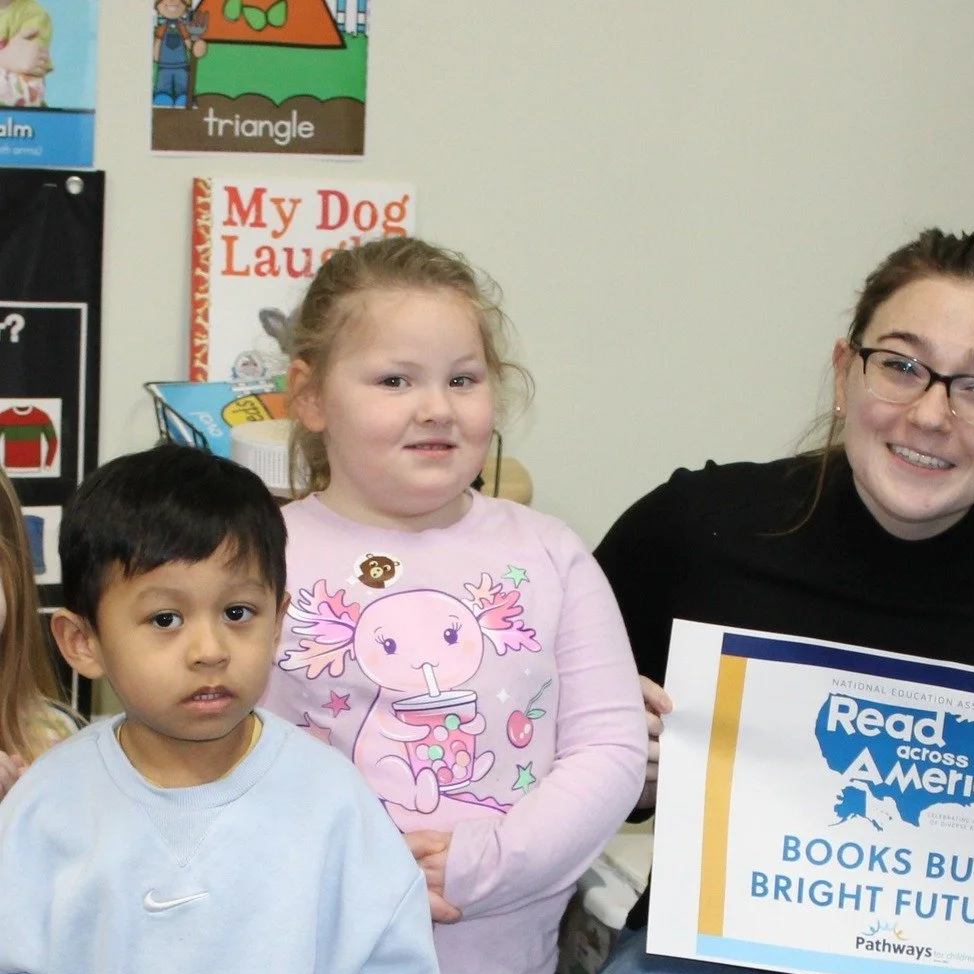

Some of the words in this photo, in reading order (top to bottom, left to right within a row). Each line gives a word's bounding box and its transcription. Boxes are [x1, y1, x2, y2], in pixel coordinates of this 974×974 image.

[204, 107, 315, 145] triangle
[222, 186, 302, 239] My
[315, 189, 409, 237] Dog
[221, 235, 361, 278] Lau
[832, 678, 887, 694] NATIONAL
[891, 688, 954, 706] EDUCATION
[827, 696, 946, 748] Read
[896, 744, 970, 768] across
[782, 834, 912, 876] BOOKS
[751, 870, 883, 913] BRIGHT
[856, 936, 932, 960] Pathways
